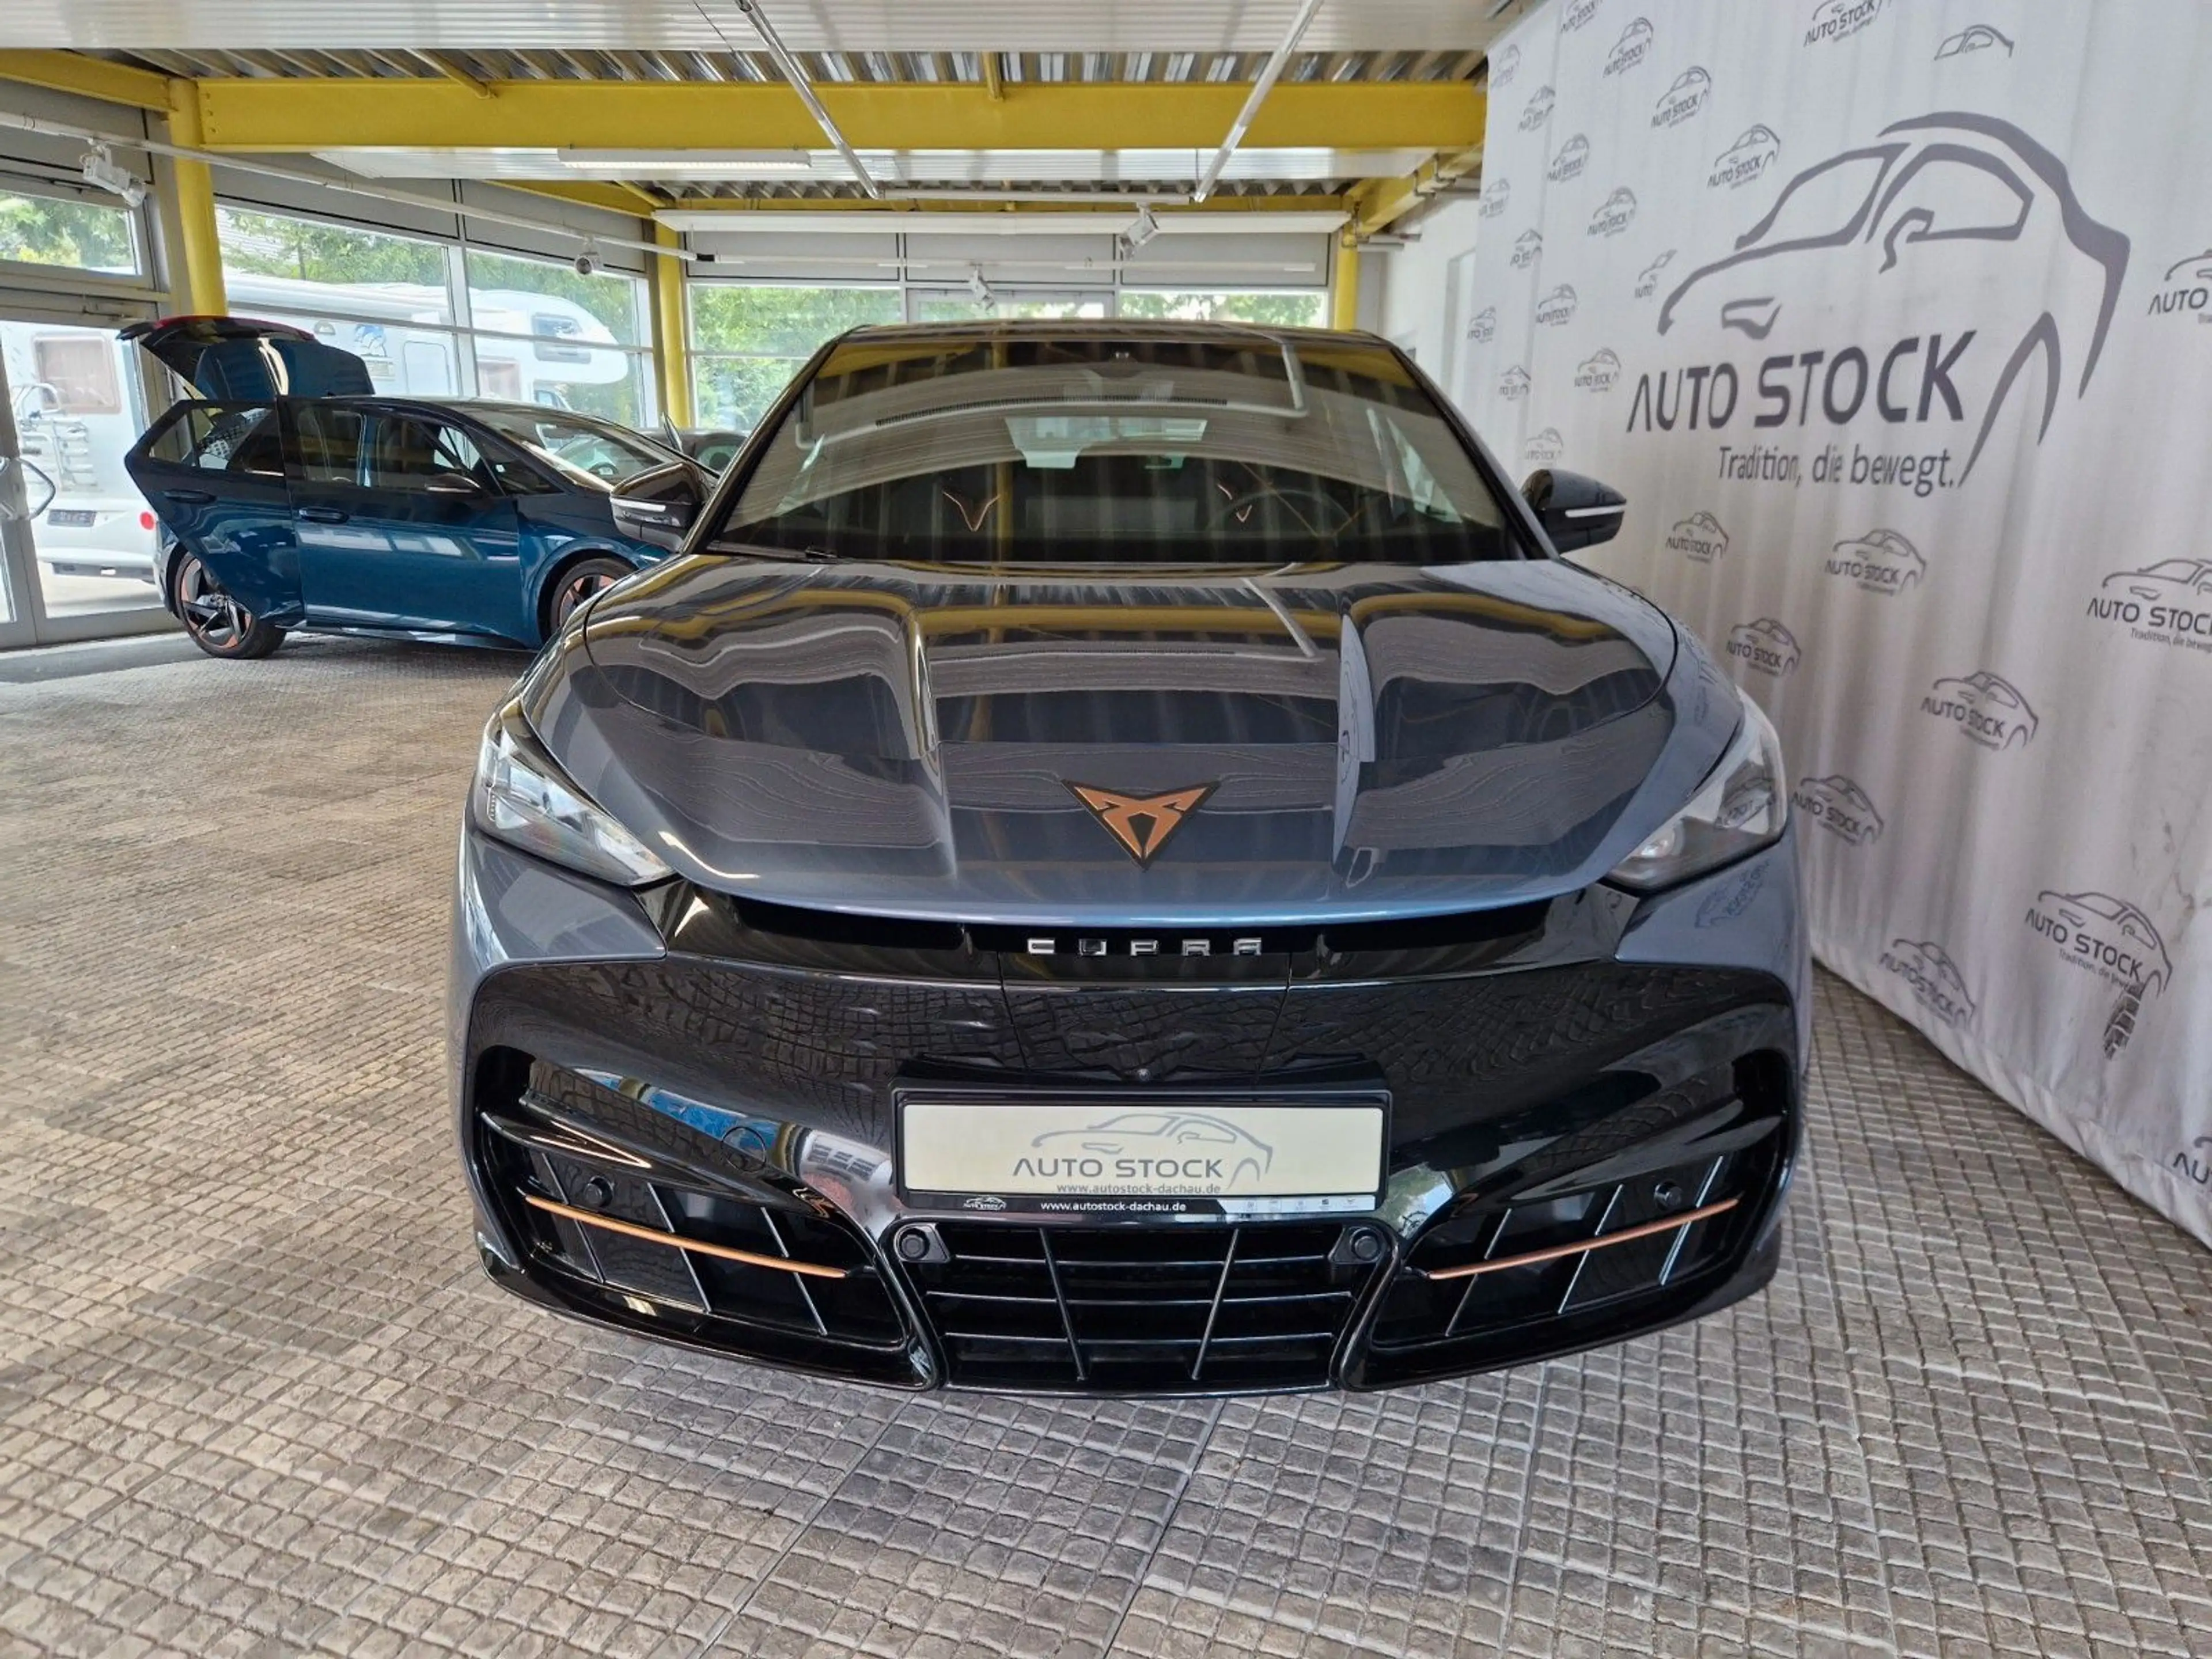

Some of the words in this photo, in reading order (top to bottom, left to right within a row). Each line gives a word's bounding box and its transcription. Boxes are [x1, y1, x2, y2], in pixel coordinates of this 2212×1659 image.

[1803, 18, 1837, 47] AUTO
[1839, 0, 1875, 30] STOCK
[1706, 166, 1733, 189] AUTO
[1735, 154, 1762, 179] STOCK
[2147, 287, 2209, 316] AUTO
[1626, 362, 1738, 433] AUTO
[1753, 328, 1978, 428] STOCK
[1718, 445, 1802, 488] Tradition,
[1812, 444, 1843, 484] die
[1849, 442, 1955, 498] bewegt.
[1825, 558, 1862, 578] AUTO
[2086, 597, 2140, 623] AUTO
[2148, 605, 2212, 635] STOC
[1920, 696, 1967, 722] AUTO
[1027, 936, 1263, 957] CUPRA
[2025, 907, 2068, 944] AUTO
[2074, 933, 2143, 984] STOCK
[1012, 1157, 1103, 1177] AUTO
[1115, 1158, 1224, 1178] STOCK
[1056, 1183, 1222, 1195] www.autostock-dachau.de
[1040, 1199, 1187, 1213] www.autostock-dachau.de
